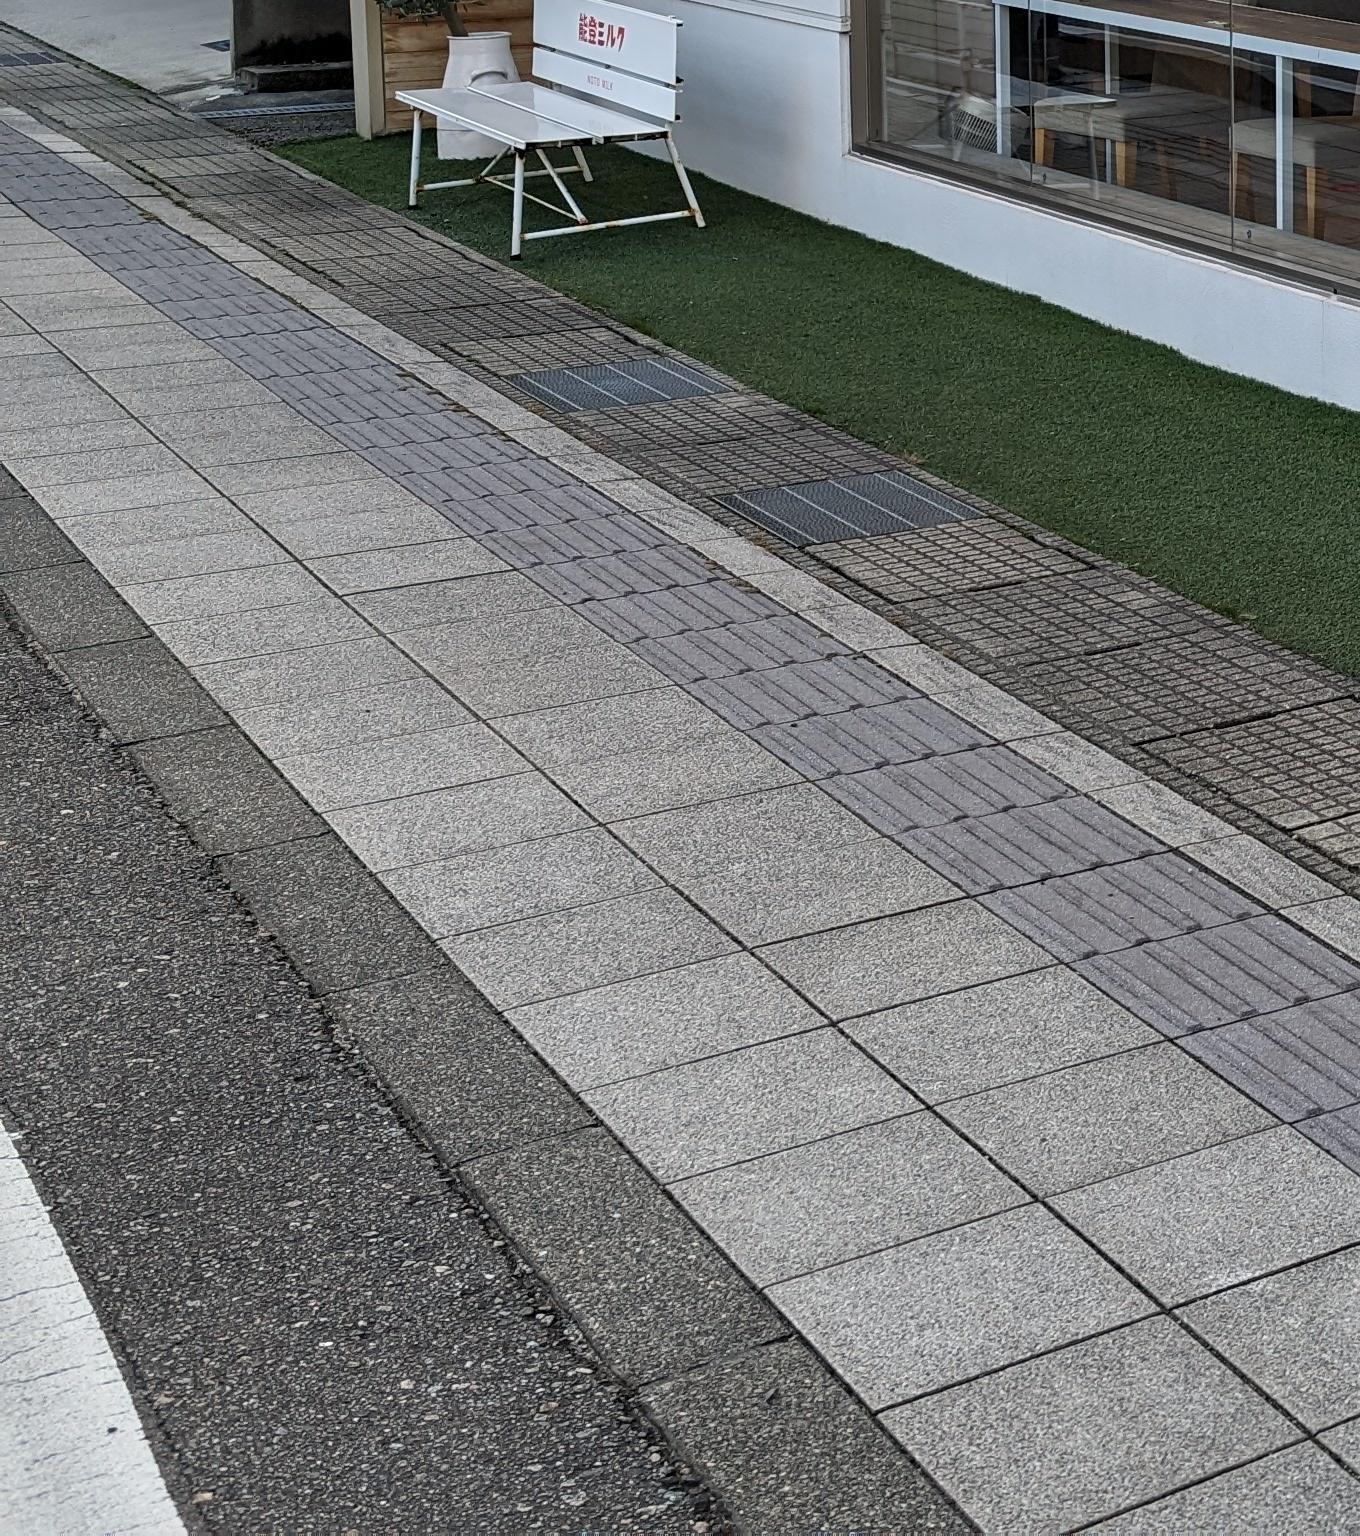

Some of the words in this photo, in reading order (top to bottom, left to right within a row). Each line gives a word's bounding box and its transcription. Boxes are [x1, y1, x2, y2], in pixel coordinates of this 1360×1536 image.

[578, 13, 626, 53] 能登ミルク
